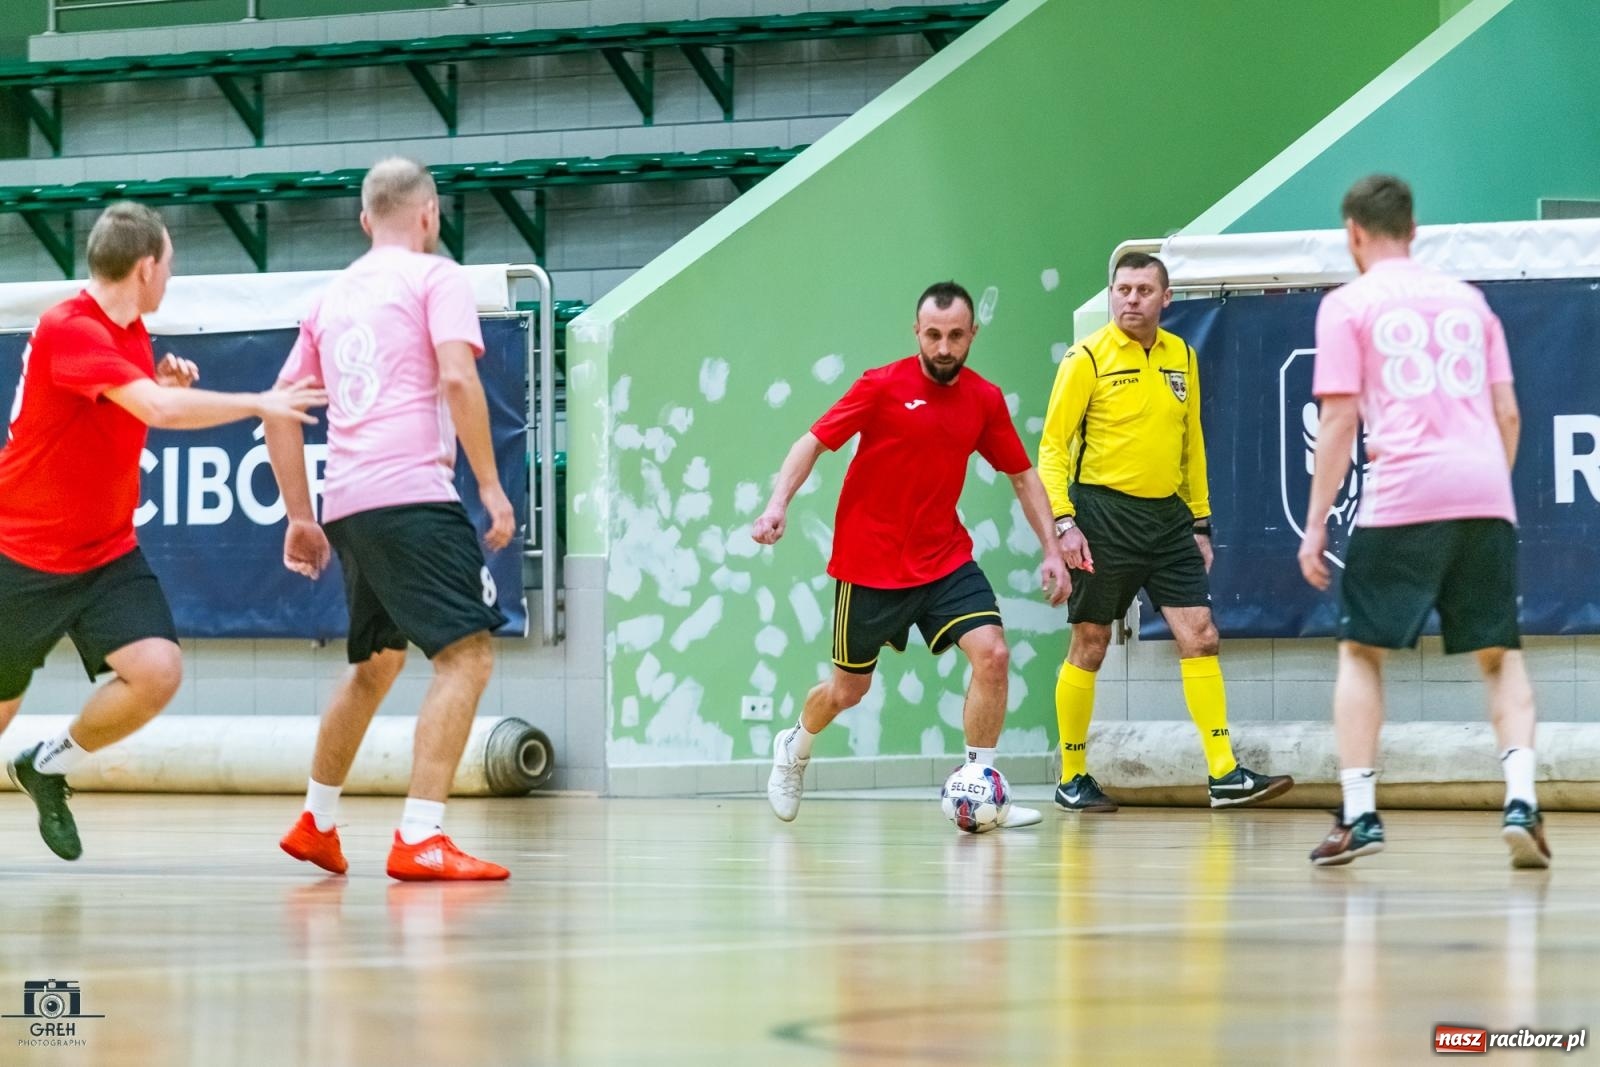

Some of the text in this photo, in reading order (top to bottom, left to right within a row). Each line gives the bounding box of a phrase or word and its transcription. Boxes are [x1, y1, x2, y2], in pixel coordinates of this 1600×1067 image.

[334, 320, 380, 422] 8
[1372, 307, 1487, 400] 88
[1553, 413, 1600, 504] R
[480, 565, 498, 608] 8
[950, 781, 987, 796] SELECT
